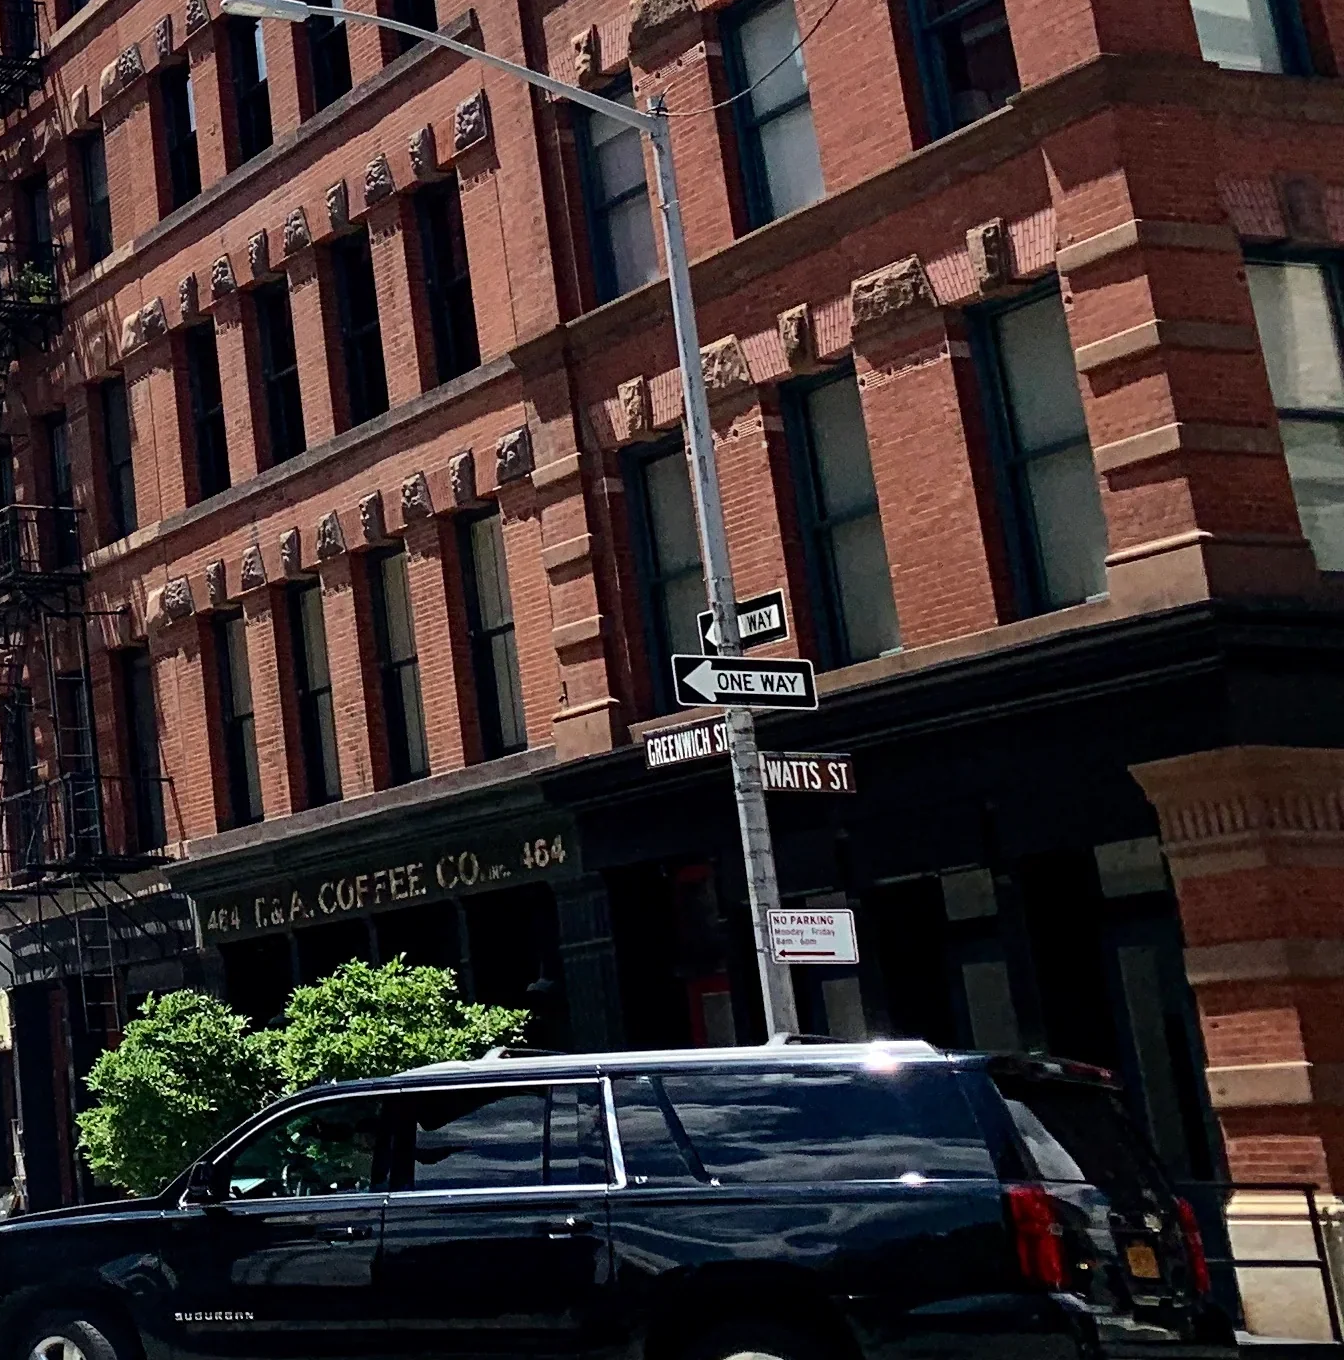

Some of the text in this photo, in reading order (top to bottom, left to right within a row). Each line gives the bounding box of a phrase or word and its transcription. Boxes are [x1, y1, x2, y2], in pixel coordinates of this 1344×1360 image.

[747, 610, 772, 632] WAY
[717, 672, 798, 693] ONE WAY
[647, 723, 728, 767] GREENWICH ST
[766, 760, 848, 790] WATTS ST
[318, 862, 427, 915] COFFEE
[773, 916, 834, 925] NO PARKING
[174, 1311, 254, 1321] SUBURBAN
